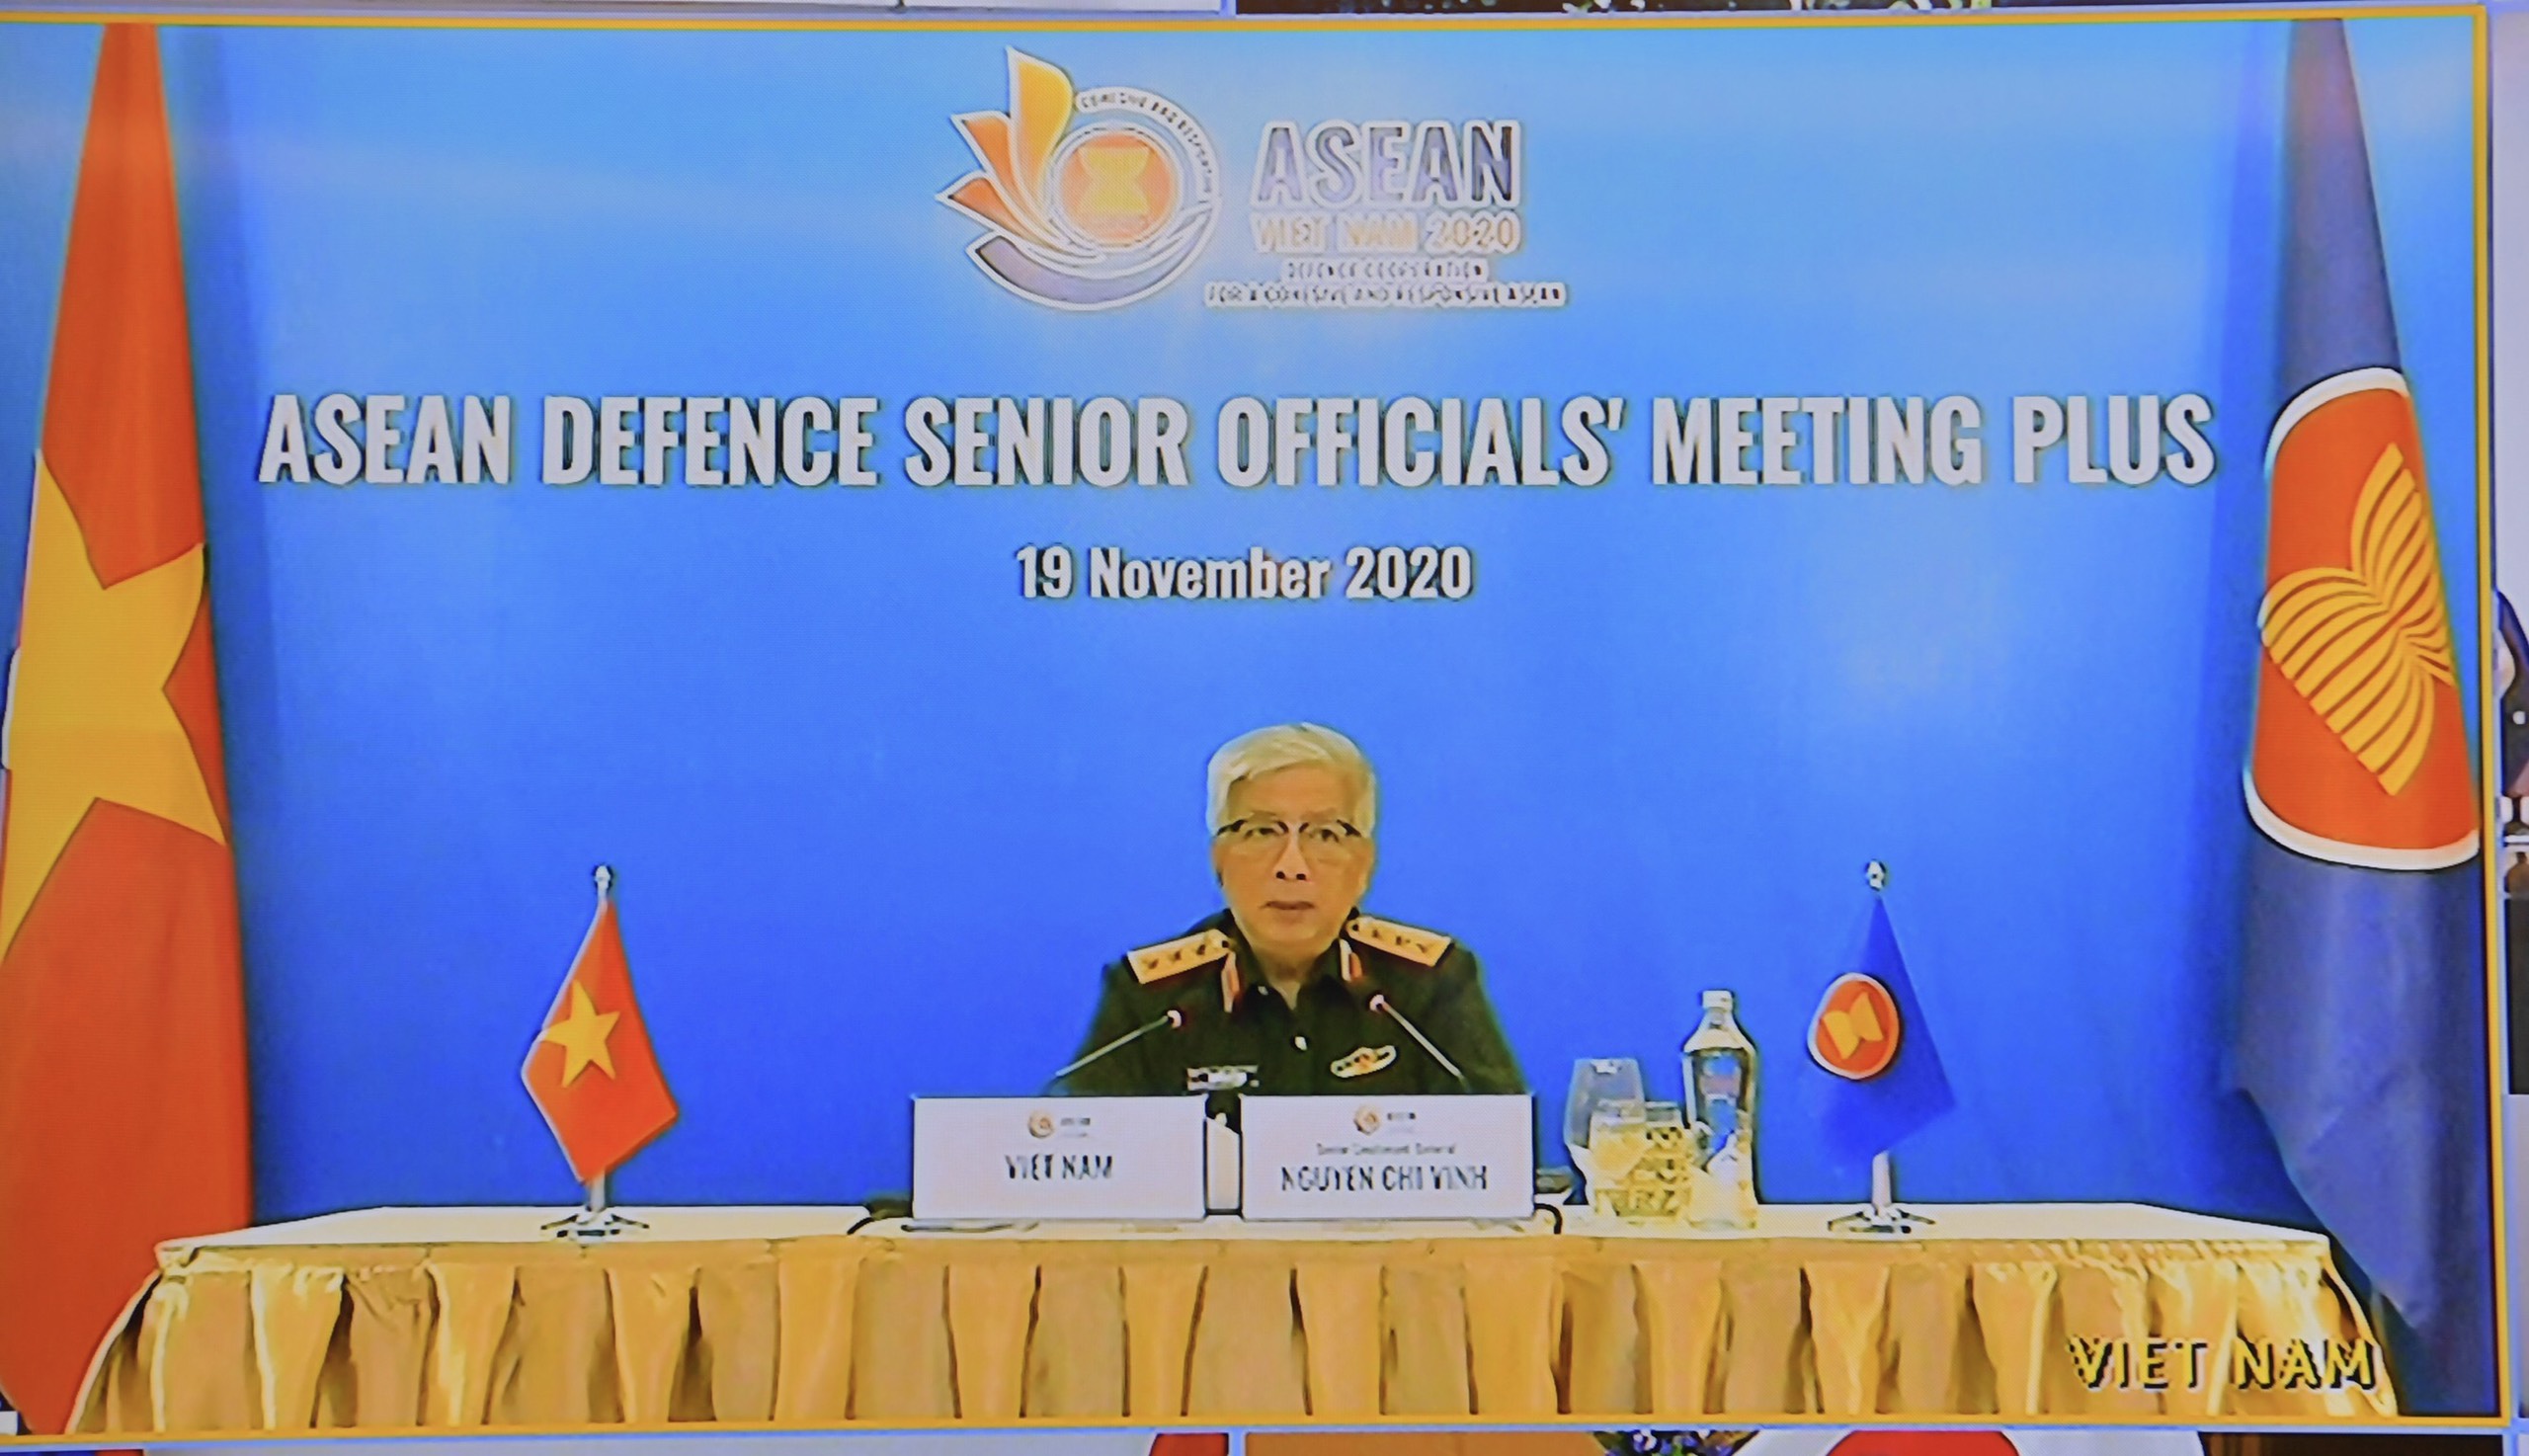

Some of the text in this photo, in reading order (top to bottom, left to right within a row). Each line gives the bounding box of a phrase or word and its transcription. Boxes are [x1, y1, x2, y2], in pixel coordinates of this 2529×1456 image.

[1255, 123, 1516, 204] ASEAN
[1427, 213, 1518, 251] 2020
[259, 393, 2215, 487] ASEAN DEFENCE SENIOR OFFICIALS' MEETING PLUS
[1016, 544, 1473, 600] 19 November 2020
[1004, 1153, 1112, 1180] VIET NAM
[1382, 1165, 1424, 1191] CHI
[2068, 1335, 2376, 1391] VIET NAM
